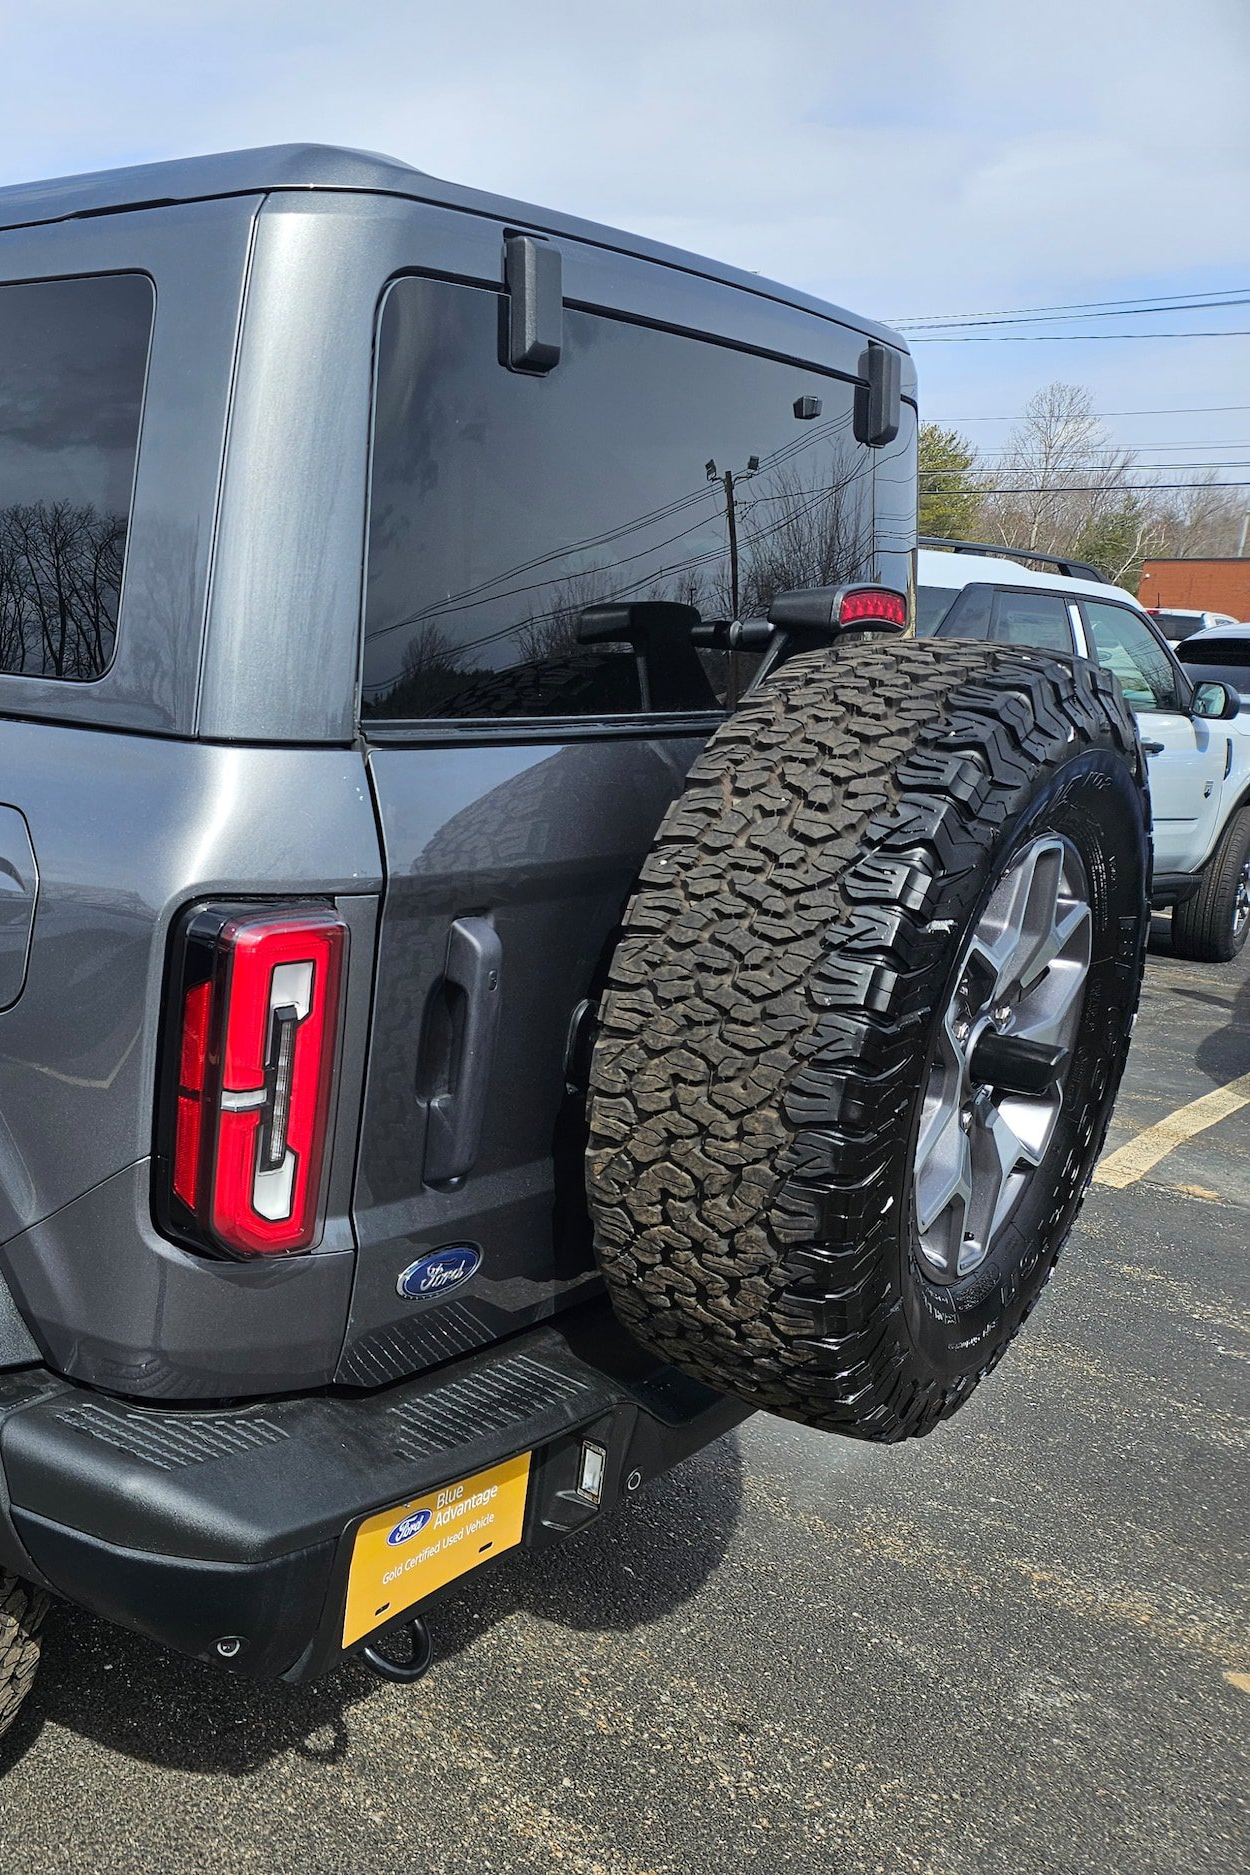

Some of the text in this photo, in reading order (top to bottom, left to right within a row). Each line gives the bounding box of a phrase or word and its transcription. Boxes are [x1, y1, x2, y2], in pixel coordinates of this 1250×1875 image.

[419, 1257, 466, 1292] Ford
[433, 1484, 499, 1530] Advantage
[436, 1485, 464, 1510] Blue
[395, 1515, 424, 1543] Ford
[382, 1512, 495, 1585] Gold Certified Used Vehicle
